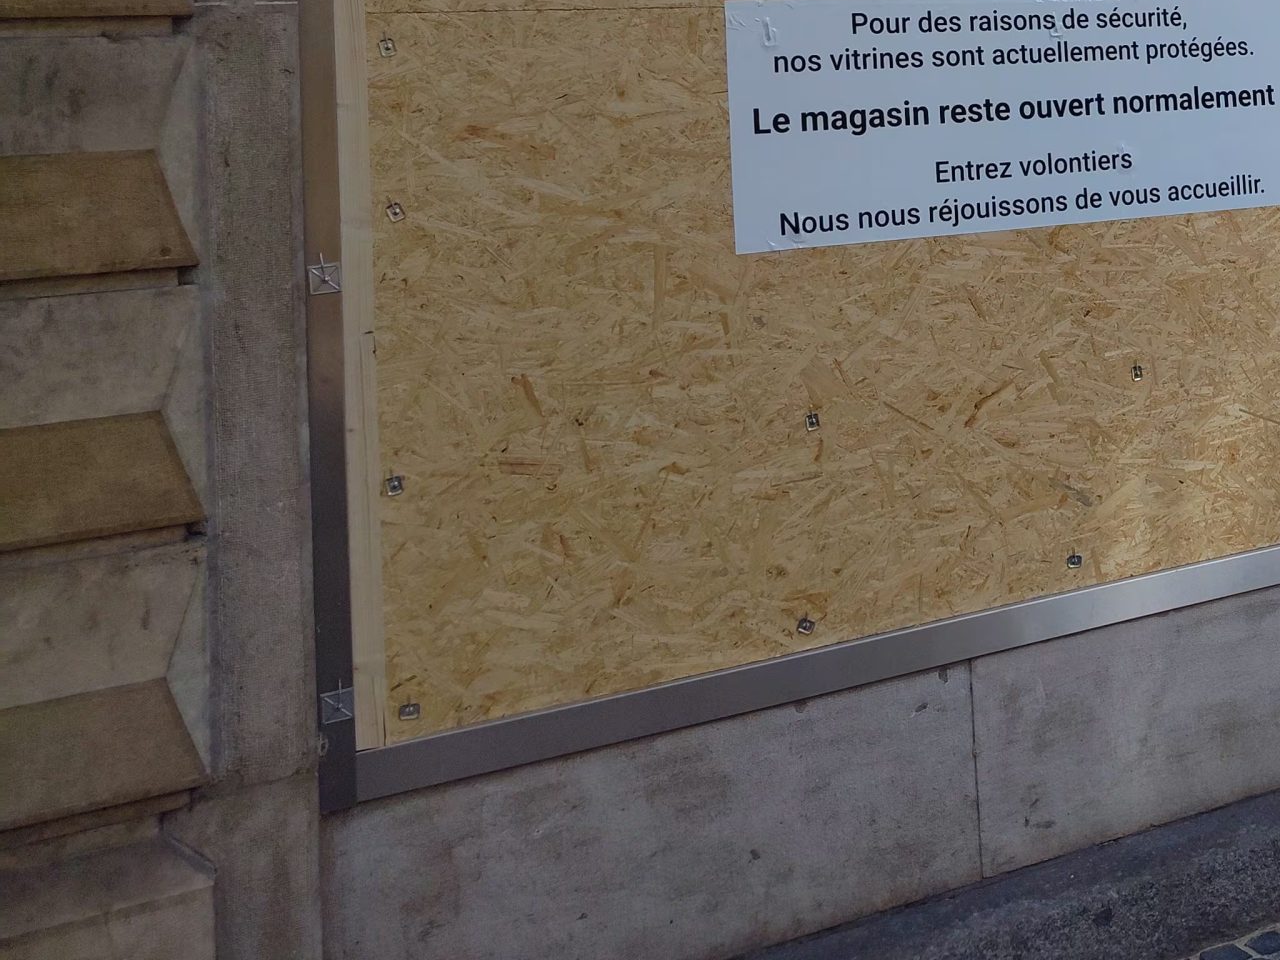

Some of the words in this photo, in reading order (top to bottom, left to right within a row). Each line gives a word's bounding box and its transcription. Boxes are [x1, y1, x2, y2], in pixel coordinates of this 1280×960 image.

[852, 13, 910, 34] Pour
[919, 11, 961, 33] des
[970, 10, 1058, 33] raisons
[1062, 8, 1089, 29] de
[1097, 6, 1186, 30] sécurité,
[774, 55, 821, 73] nos
[830, 47, 923, 70] vitrines
[932, 46, 985, 67] sont
[993, 41, 1139, 65] actuellement
[1146, 36, 1253, 64] protégées.
[753, 108, 790, 134] Le
[801, 100, 929, 135] magasin
[940, 99, 1010, 124] reste
[1019, 94, 1105, 119] ouvert
[1113, 85, 1275, 114] normalement
[936, 161, 1012, 183] Entrez
[1019, 150, 1132, 176] volontiers
[780, 212, 849, 235] Nous
[859, 208, 920, 229] nous
[929, 195, 1067, 226] réjouissons
[1076, 188, 1102, 209] de
[1109, 188, 1160, 206] vous
[1168, 175, 1264, 201] accueillir.
